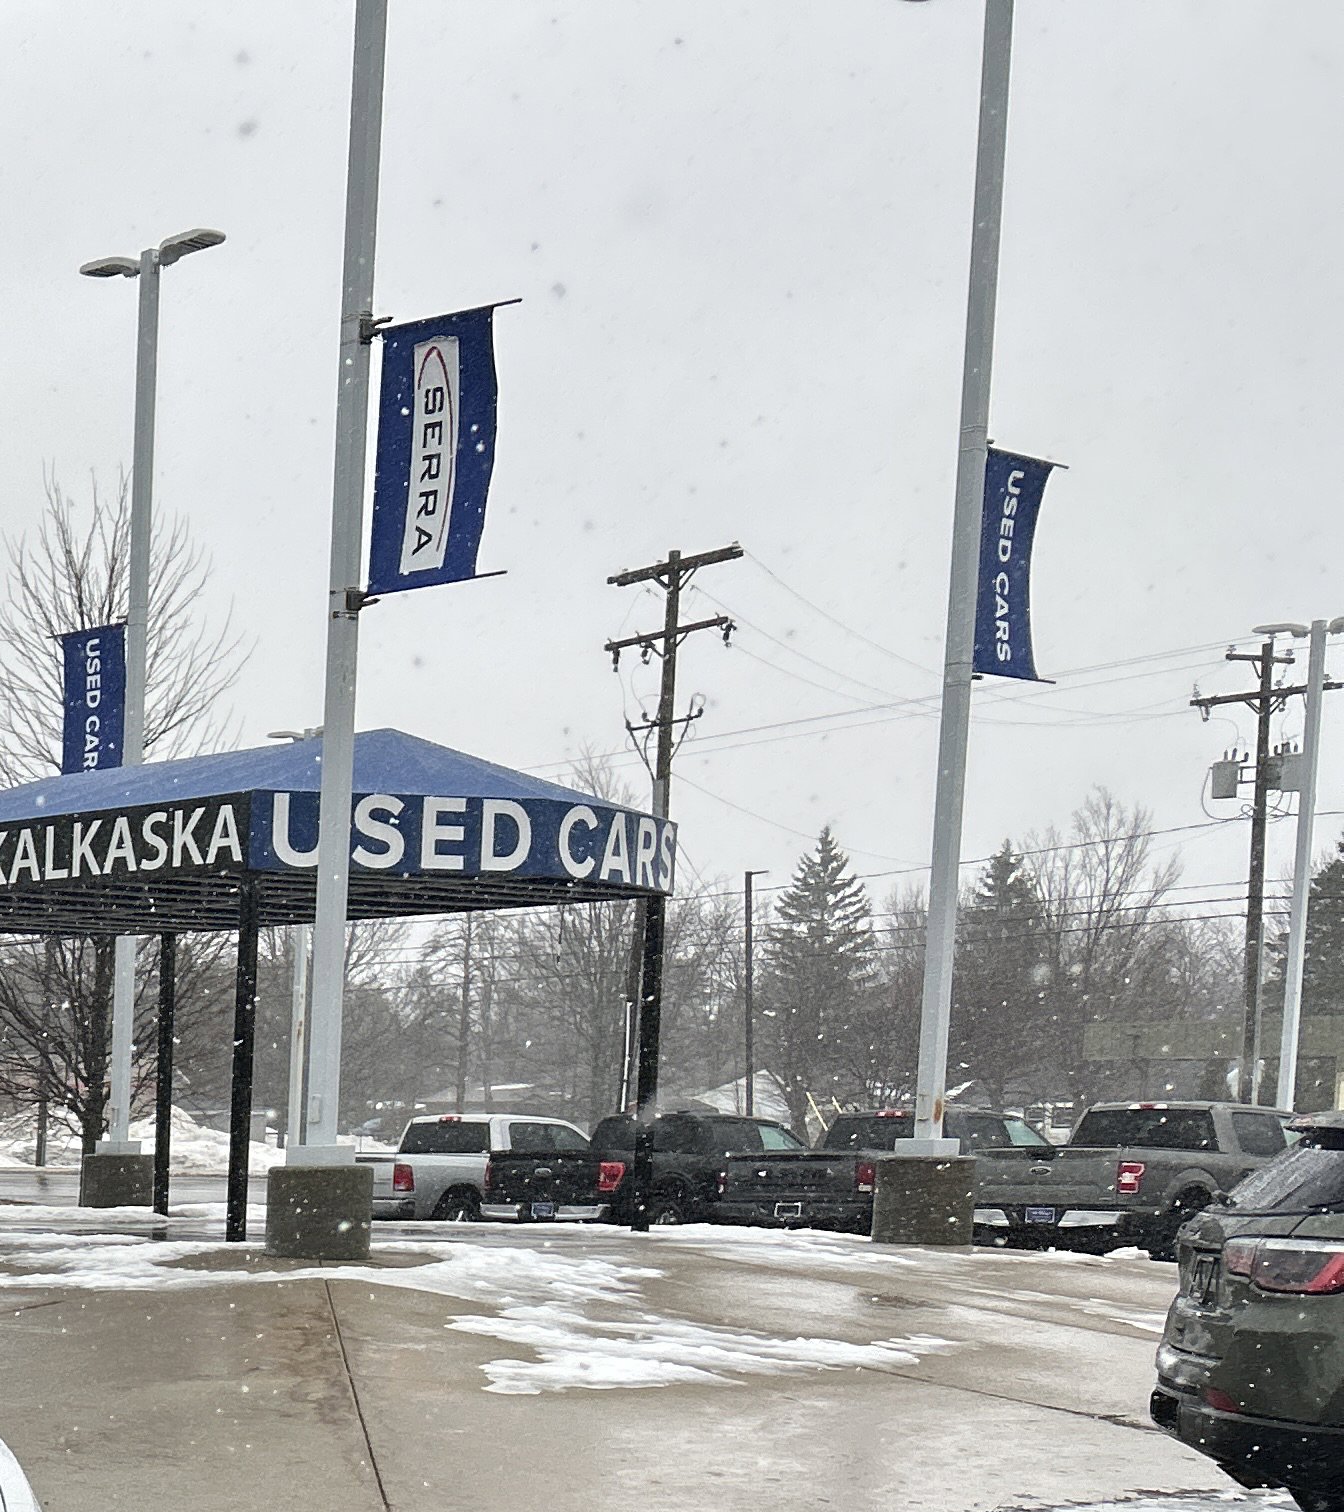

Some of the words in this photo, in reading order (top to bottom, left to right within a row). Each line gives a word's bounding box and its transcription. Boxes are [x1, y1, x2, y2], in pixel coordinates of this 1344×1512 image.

[412, 387, 444, 556] SERRA
[998, 470, 1025, 563] USED
[994, 571, 1011, 662] CARS
[85, 638, 101, 709] USED
[83, 715, 100, 773] CAR
[272, 792, 532, 871] USED
[559, 805, 674, 892] CARS
